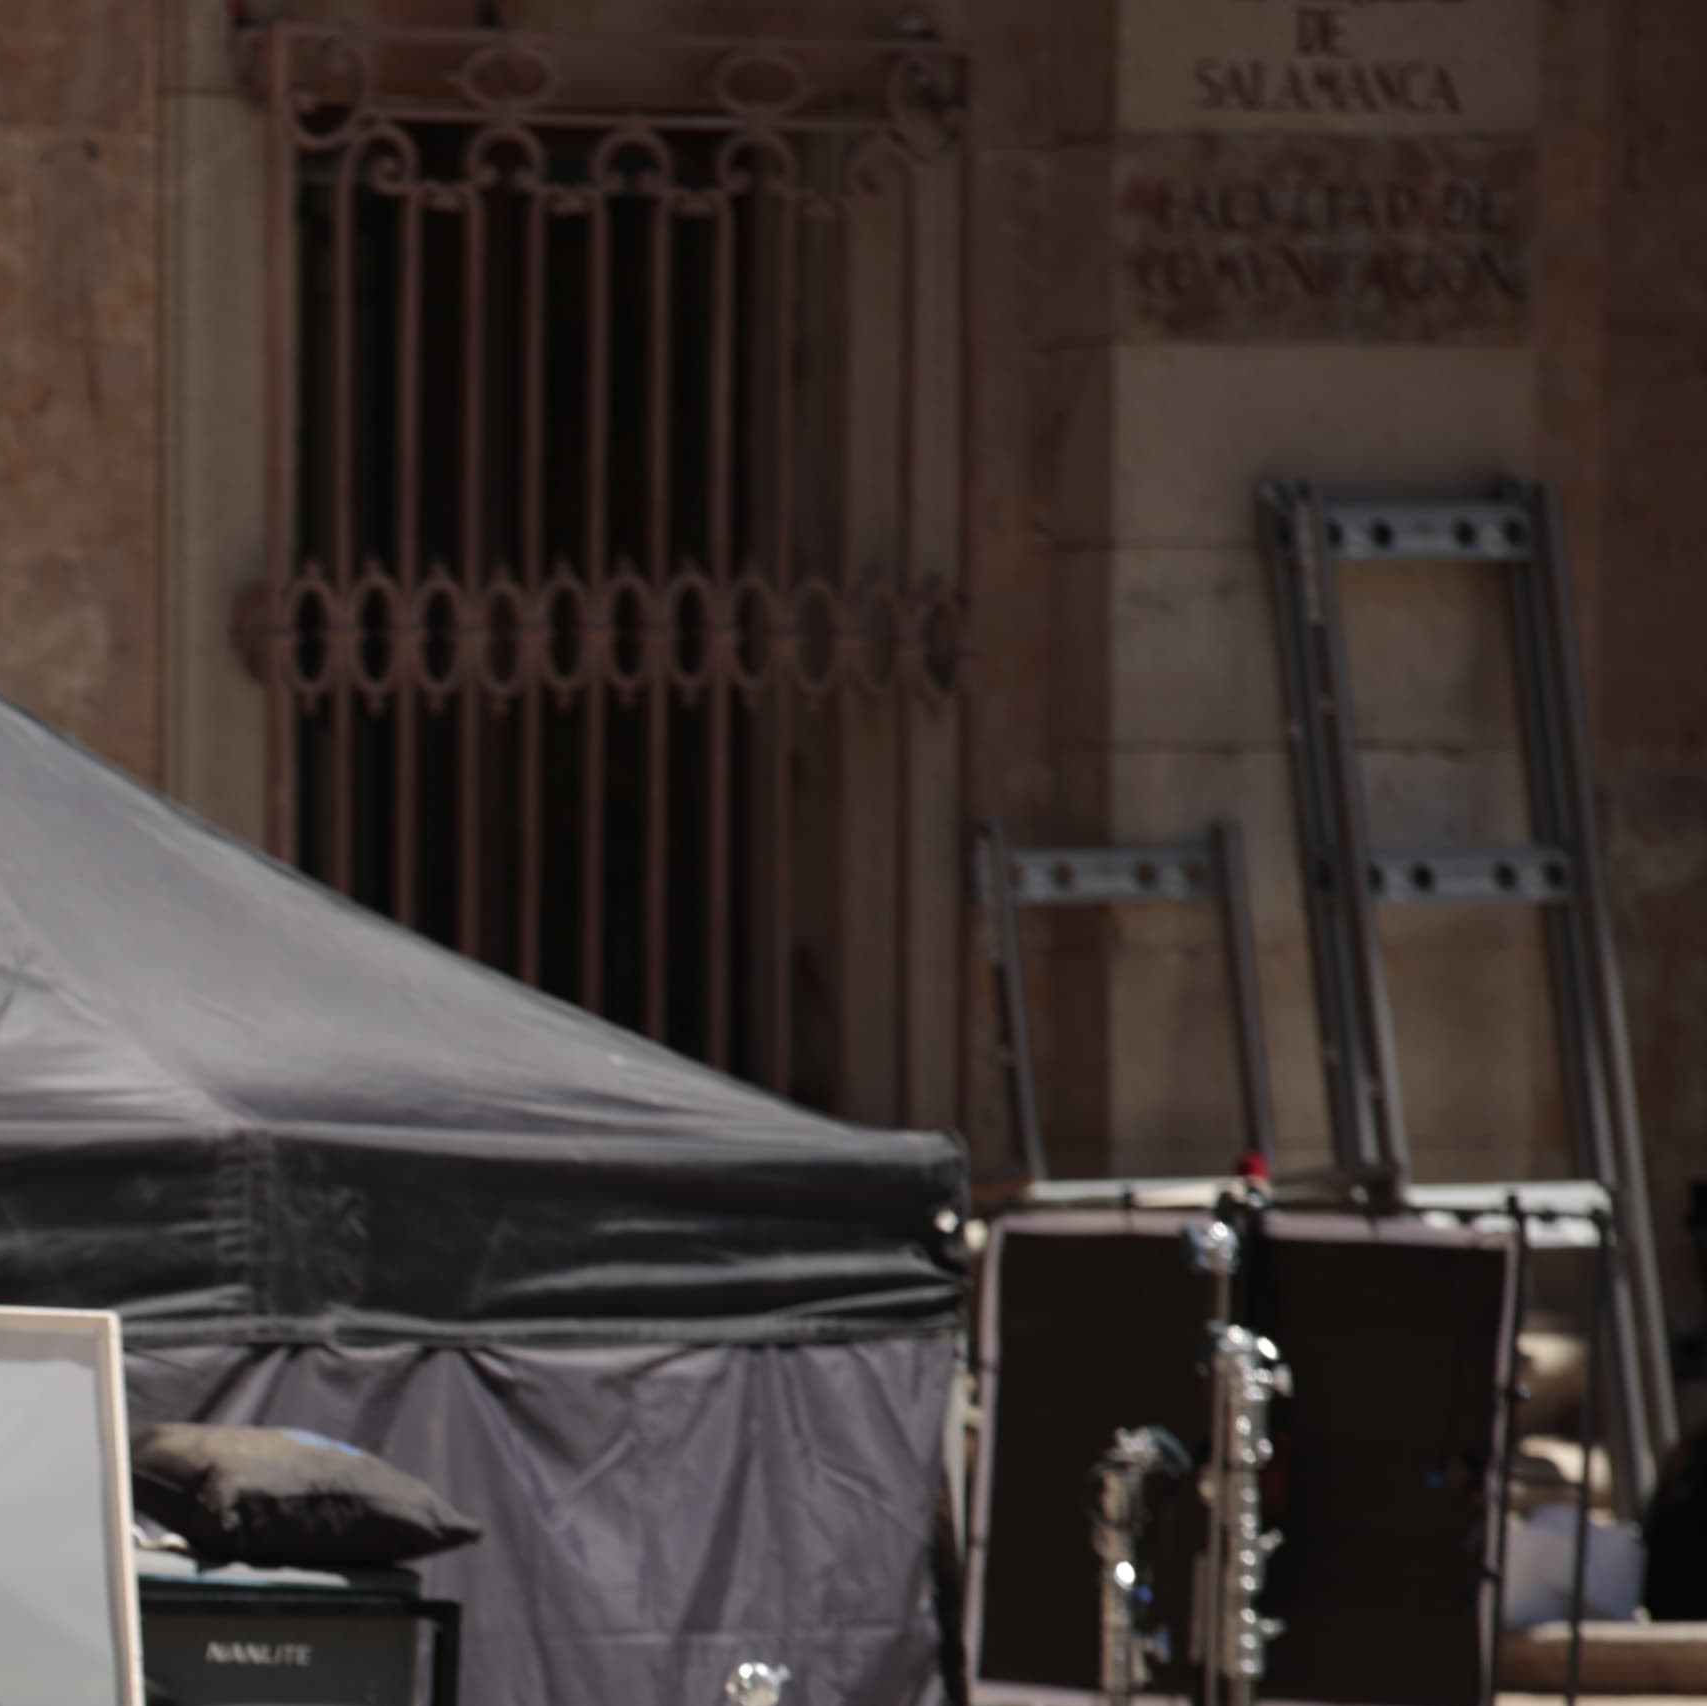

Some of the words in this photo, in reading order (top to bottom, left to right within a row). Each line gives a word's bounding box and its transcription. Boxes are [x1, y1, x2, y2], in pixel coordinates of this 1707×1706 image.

[1294, 6, 1350, 55] DE
[1194, 59, 1463, 115] SALAMANCA
[1442, 183, 1514, 237] DE
[204, 1639, 313, 1667] NANLITE
